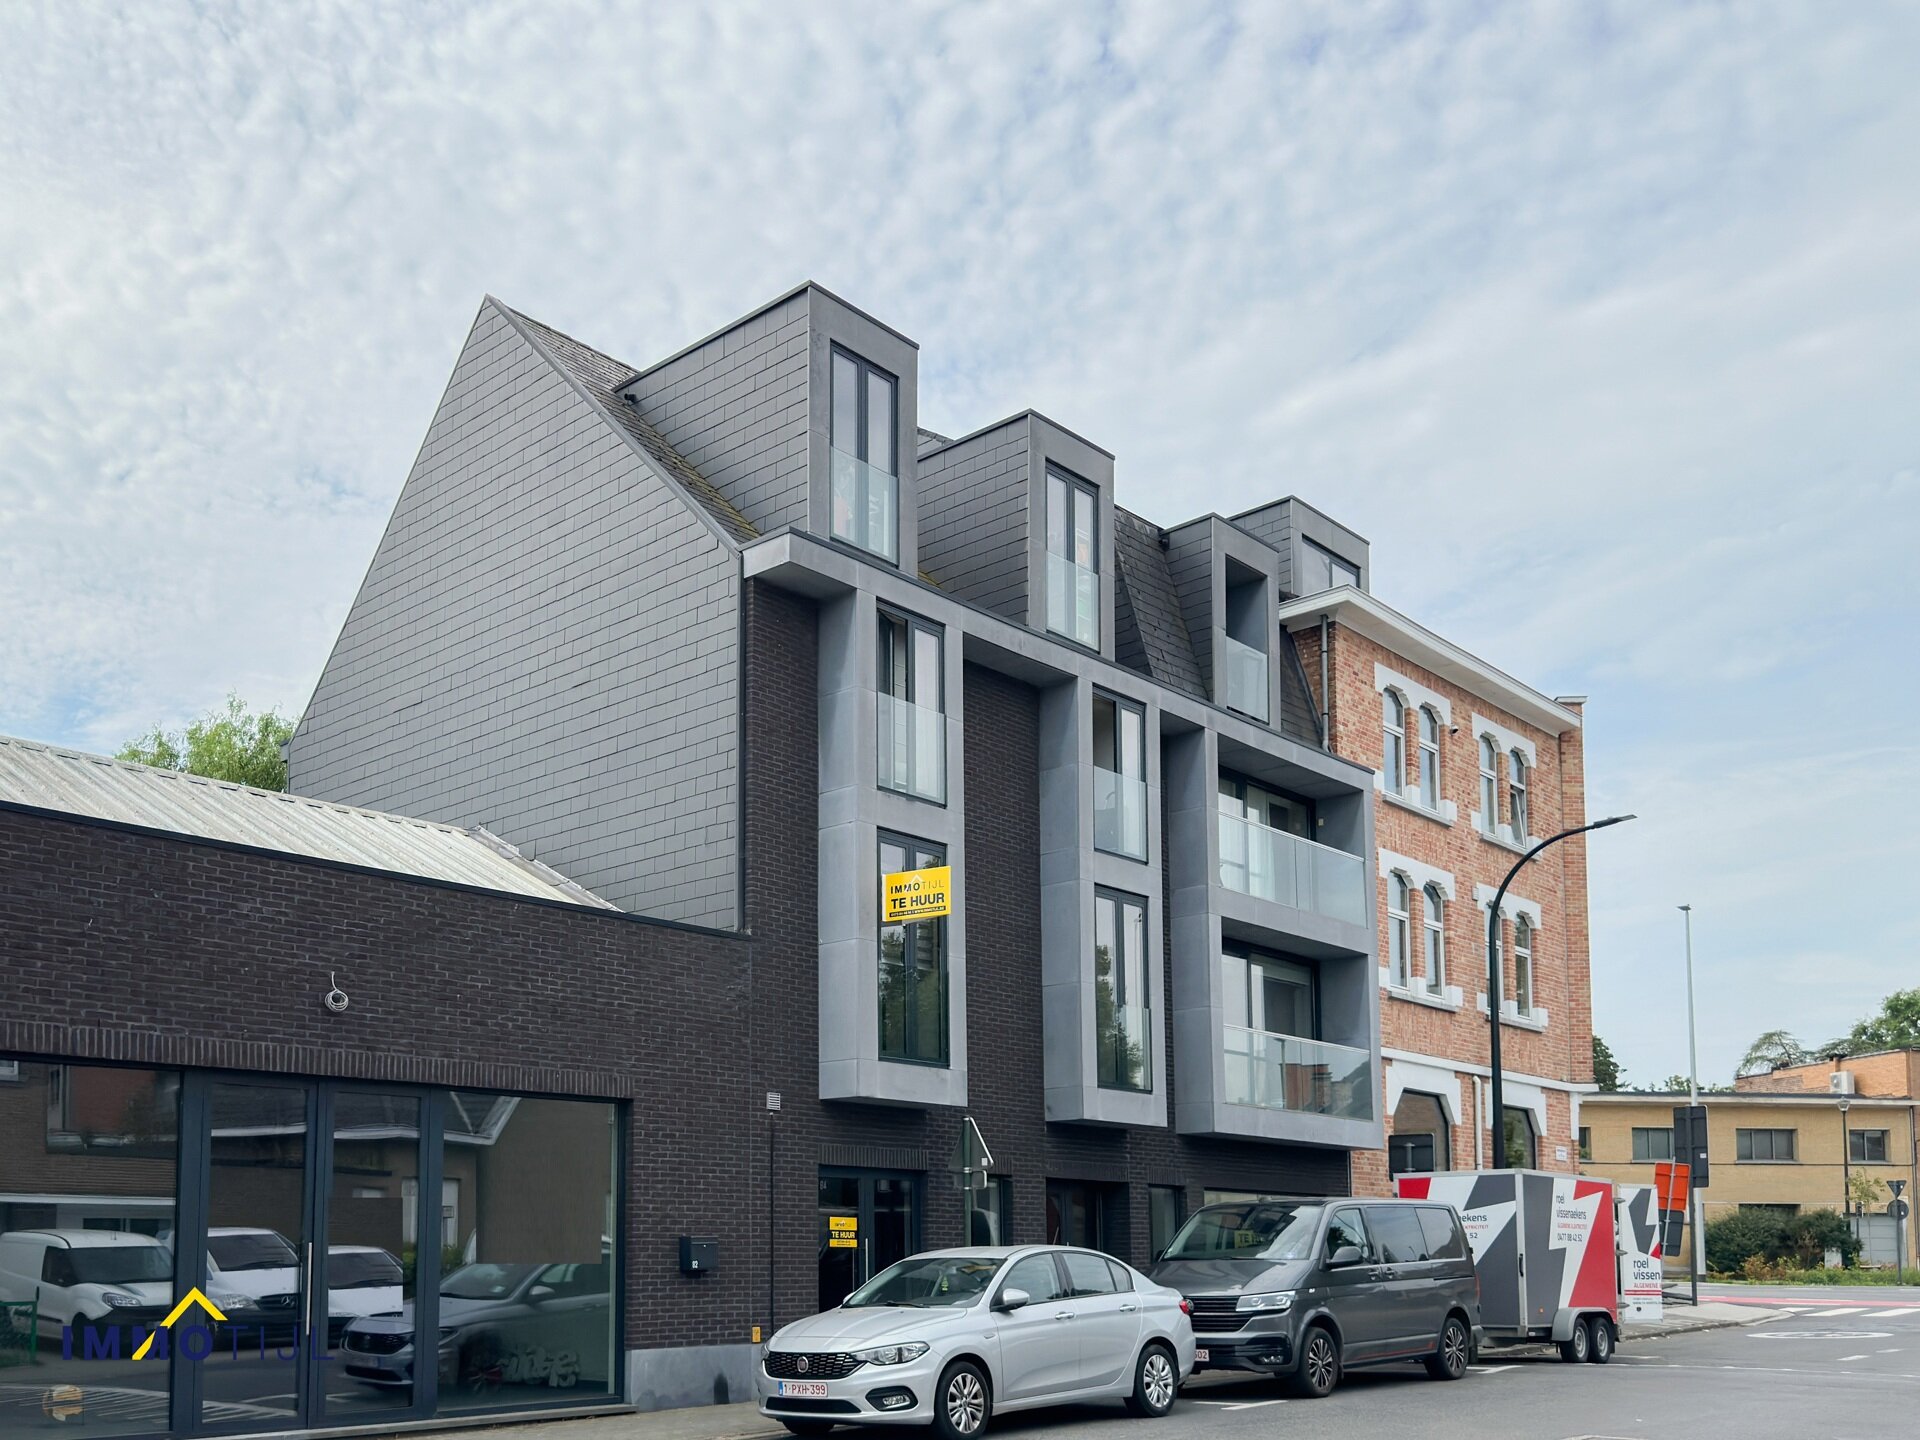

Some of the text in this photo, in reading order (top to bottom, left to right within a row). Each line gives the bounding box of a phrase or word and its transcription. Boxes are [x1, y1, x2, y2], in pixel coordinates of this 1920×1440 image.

[891, 892, 945, 910] TE HUUR
[1556, 1192, 1565, 1204] roel
[831, 1231, 856, 1239] TE HUUR
[1633, 1258, 1649, 1269] roel
[1633, 1269, 1661, 1280] vissen
